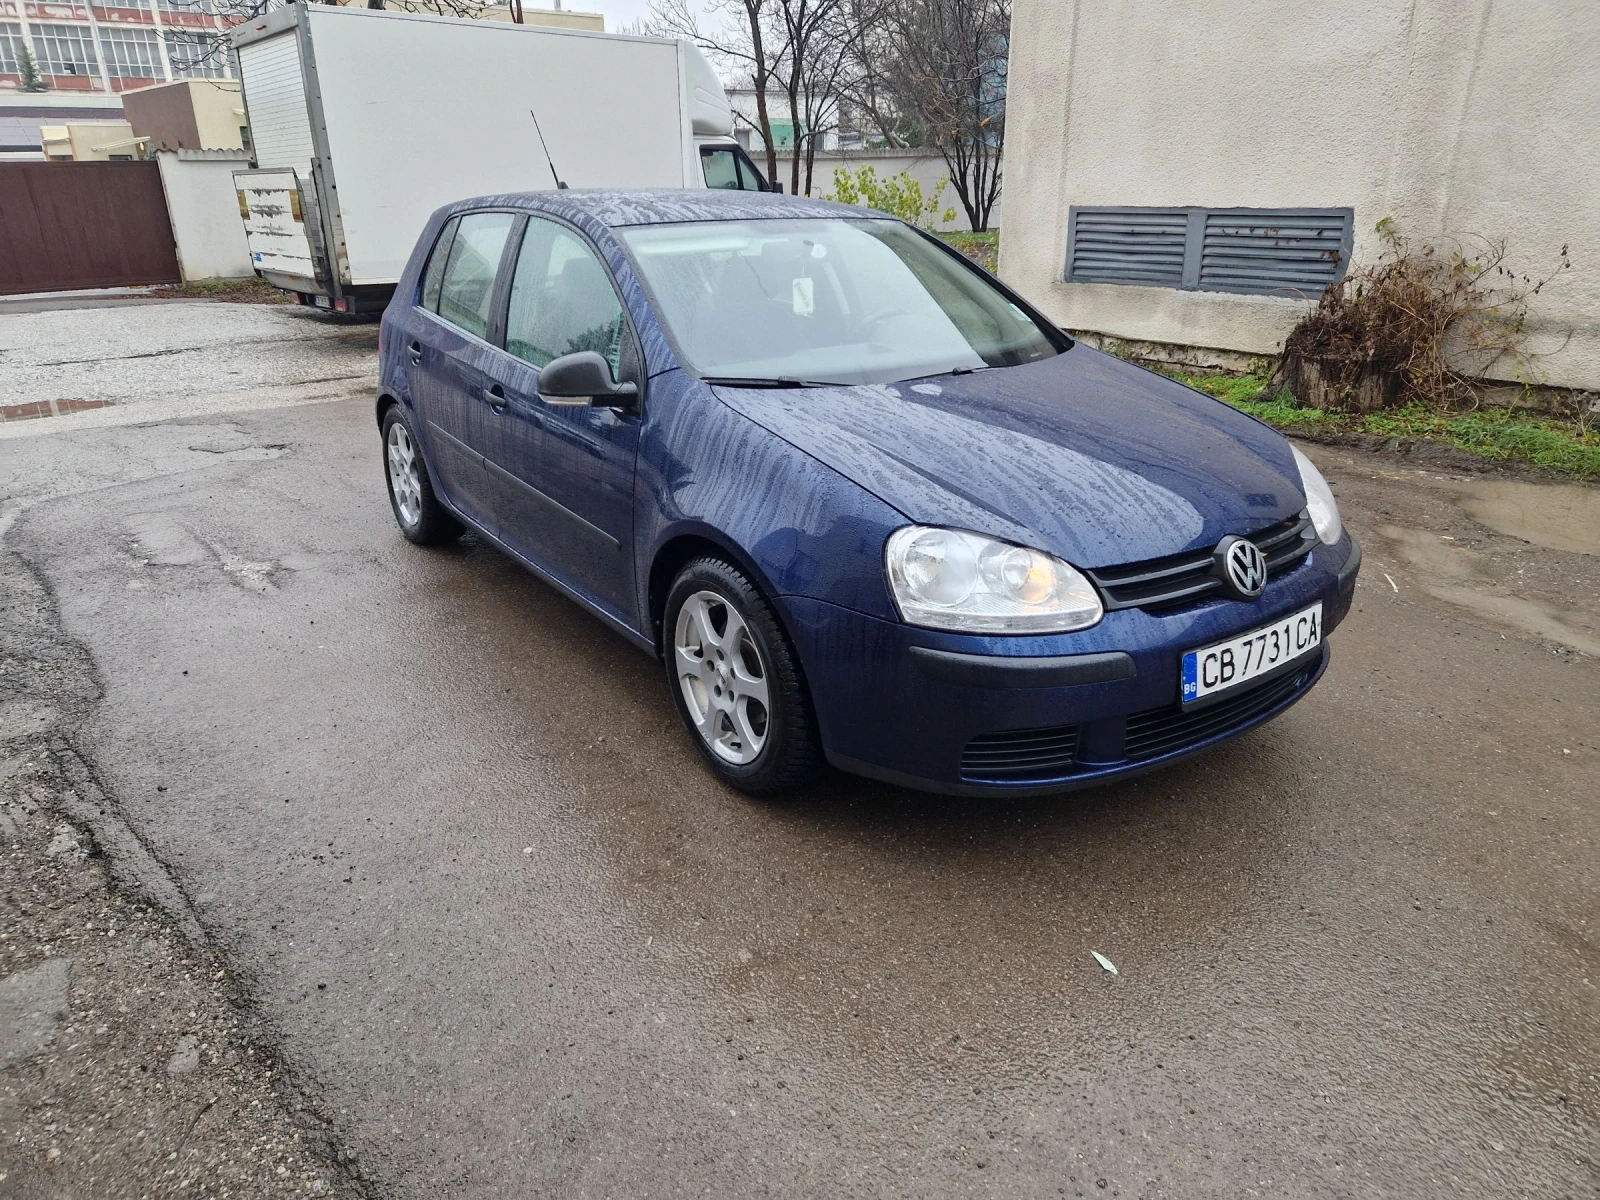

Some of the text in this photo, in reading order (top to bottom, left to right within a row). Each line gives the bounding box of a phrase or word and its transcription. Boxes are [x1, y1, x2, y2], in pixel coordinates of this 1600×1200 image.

[1229, 542, 1266, 595] VW
[1202, 611, 1318, 689] CB 7731 CA
[1183, 682, 1197, 695] BG
